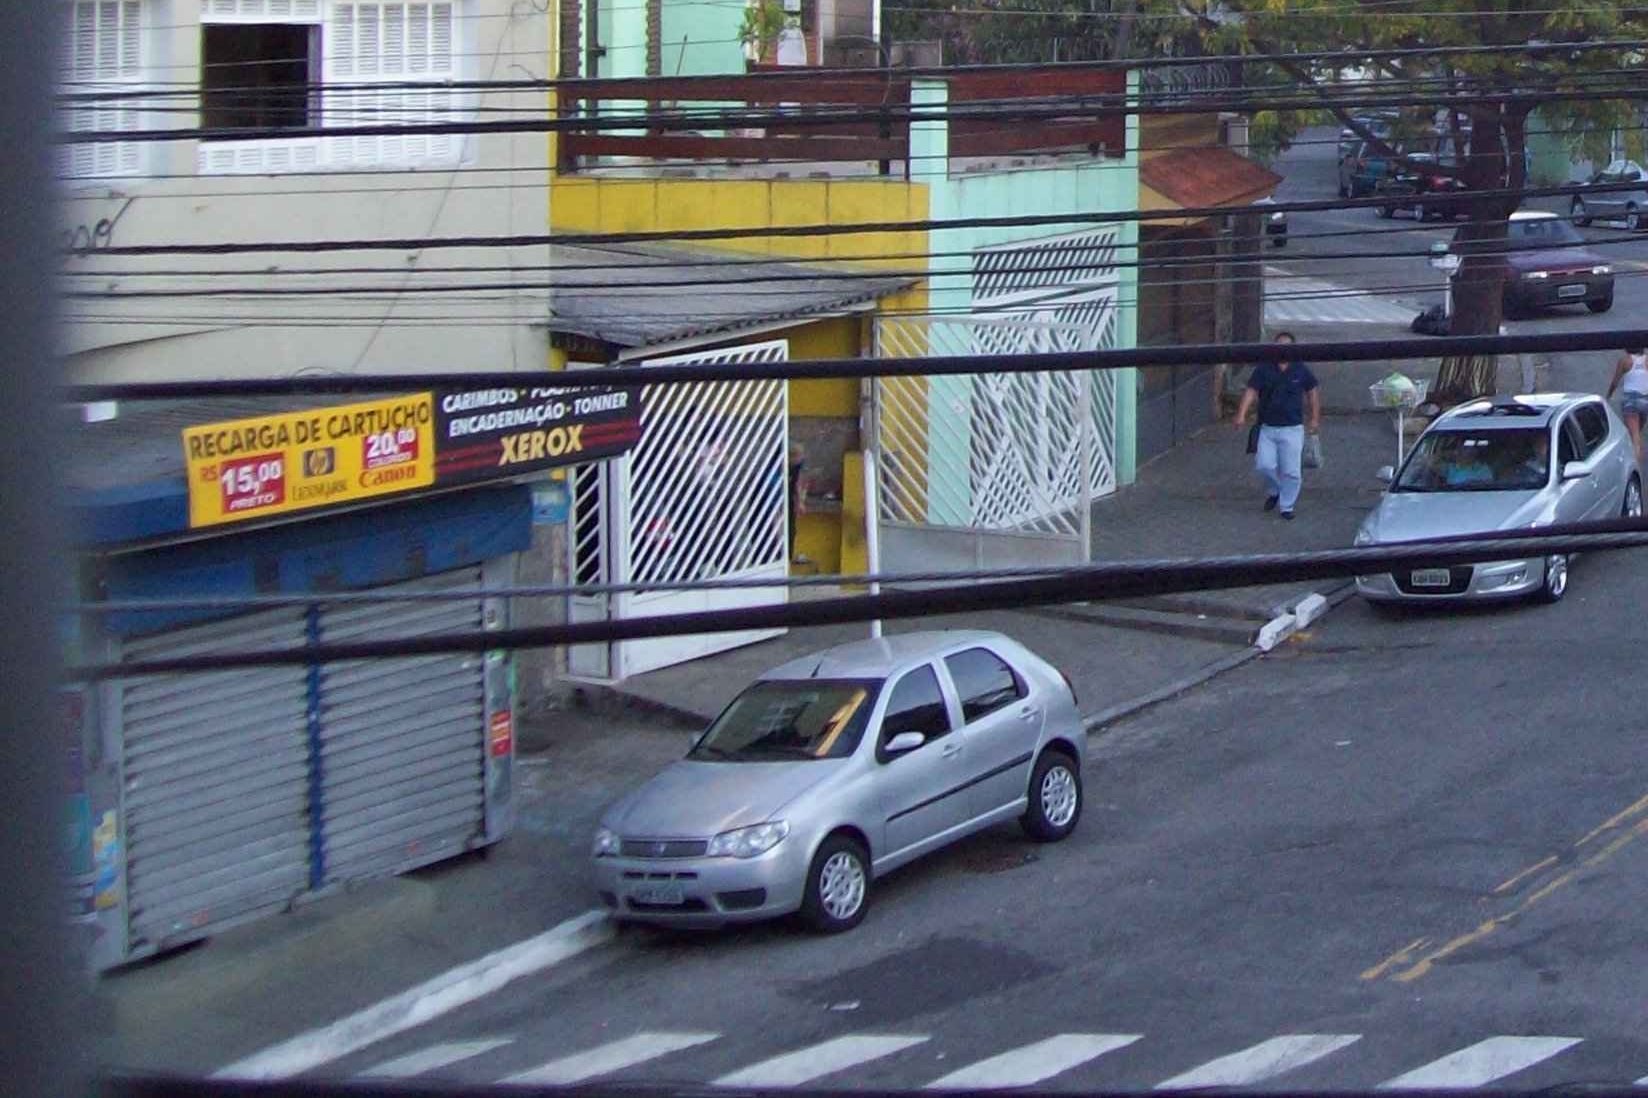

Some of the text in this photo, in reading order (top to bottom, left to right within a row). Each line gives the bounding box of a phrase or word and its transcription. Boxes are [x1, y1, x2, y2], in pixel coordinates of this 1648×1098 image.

[442, 388, 518, 413] CARIMBOS
[449, 400, 565, 437] ENCADERNAÇÃO
[574, 392, 628, 415] TONNER
[190, 401, 430, 460] RECARGA DE CARTUCHO
[366, 428, 416, 458] 20,00
[499, 425, 583, 465] XEROX
[222, 460, 282, 496] 15,00
[359, 465, 416, 488] Canon
[229, 491, 276, 511] PRETO
